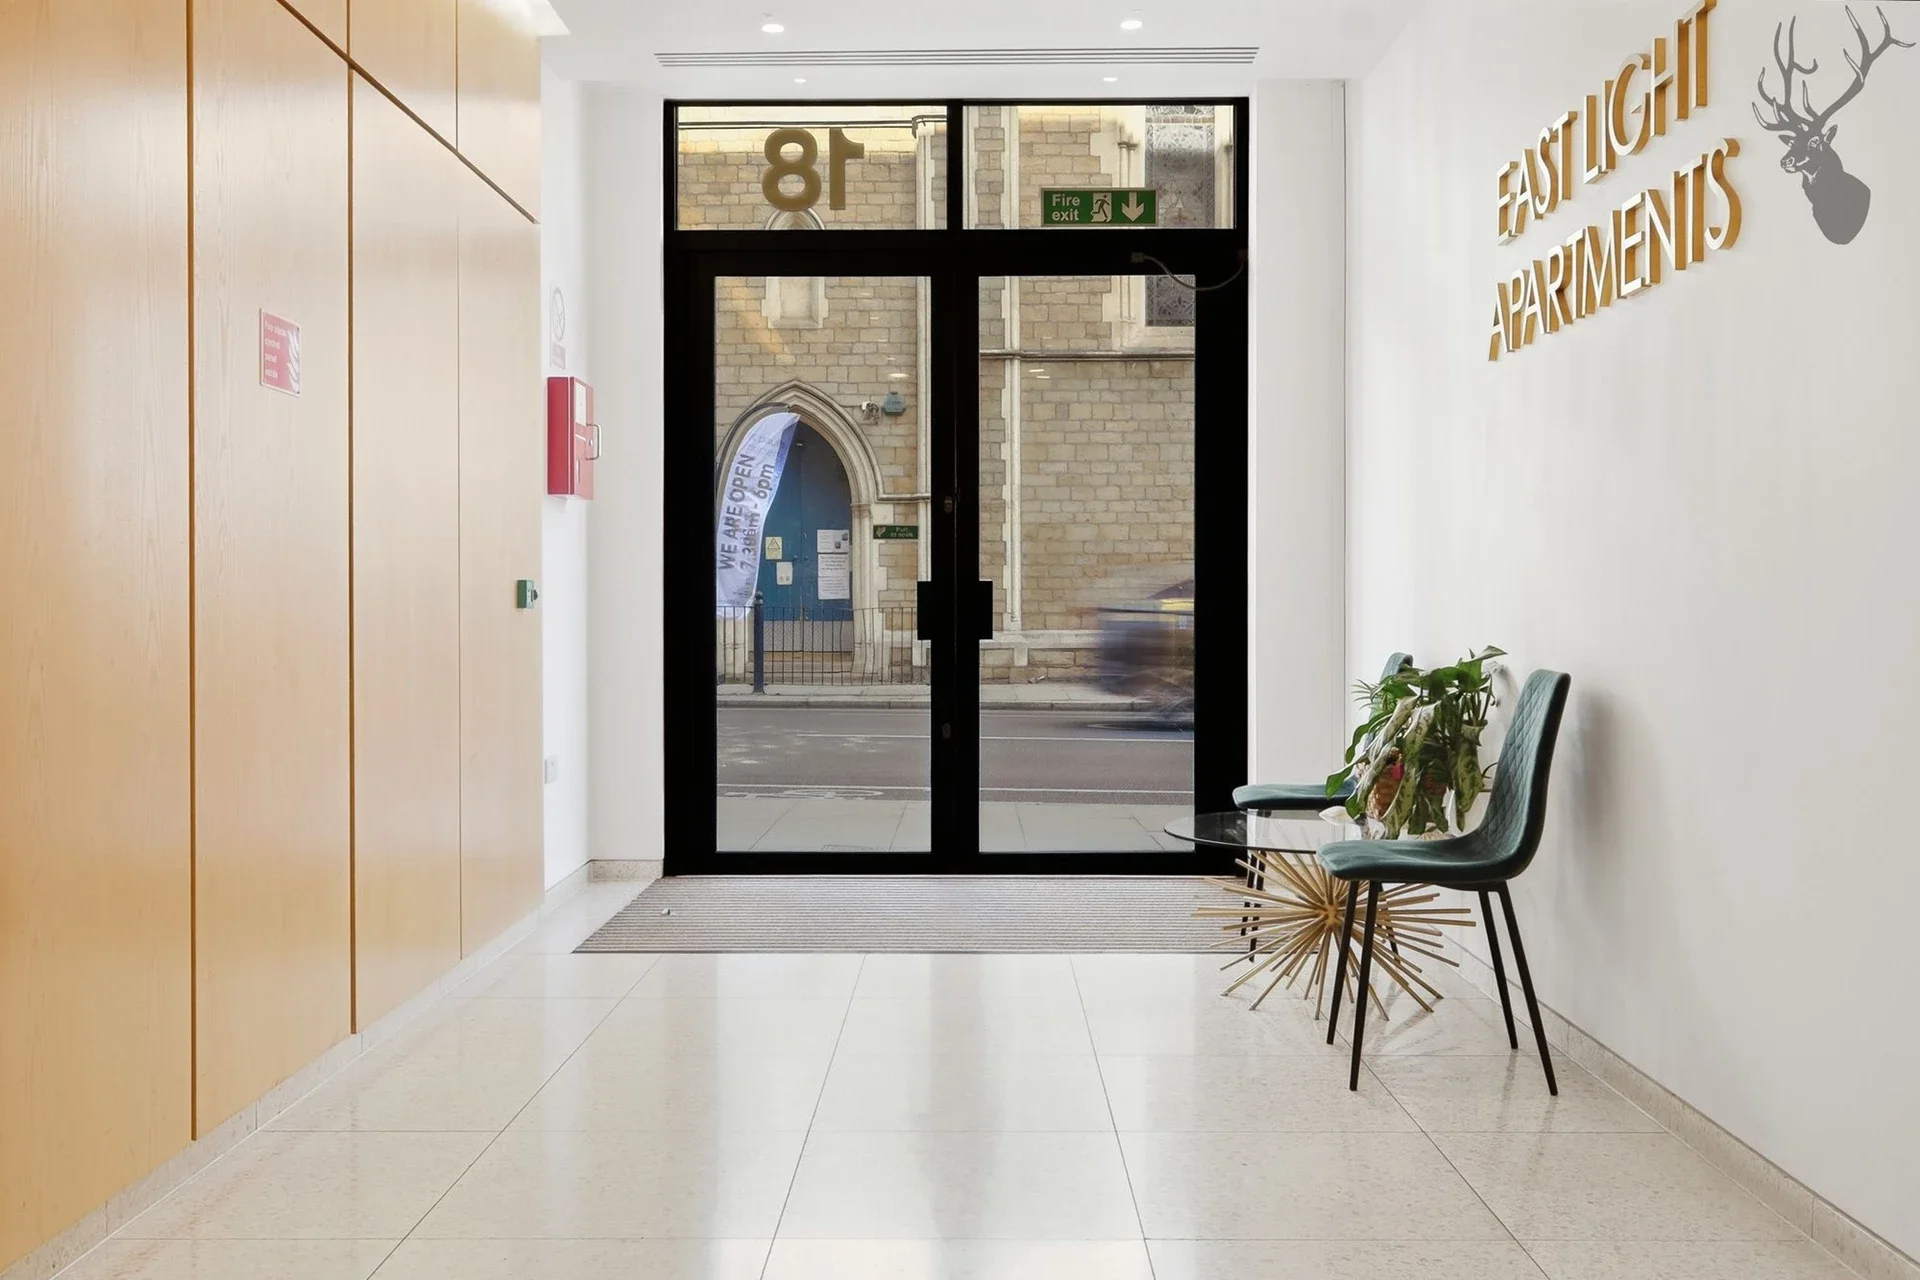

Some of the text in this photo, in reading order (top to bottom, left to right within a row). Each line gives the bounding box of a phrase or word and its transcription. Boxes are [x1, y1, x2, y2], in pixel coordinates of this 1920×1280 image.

[1497, 0, 1717, 246] EAST LIGHT
[1052, 193, 1081, 207] Fire
[1052, 208, 1079, 221] exit
[1488, 137, 1743, 361] APARTMENTS
[718, 454, 756, 570] WE ARE OPEN
[754, 463, 775, 500] 6pm
